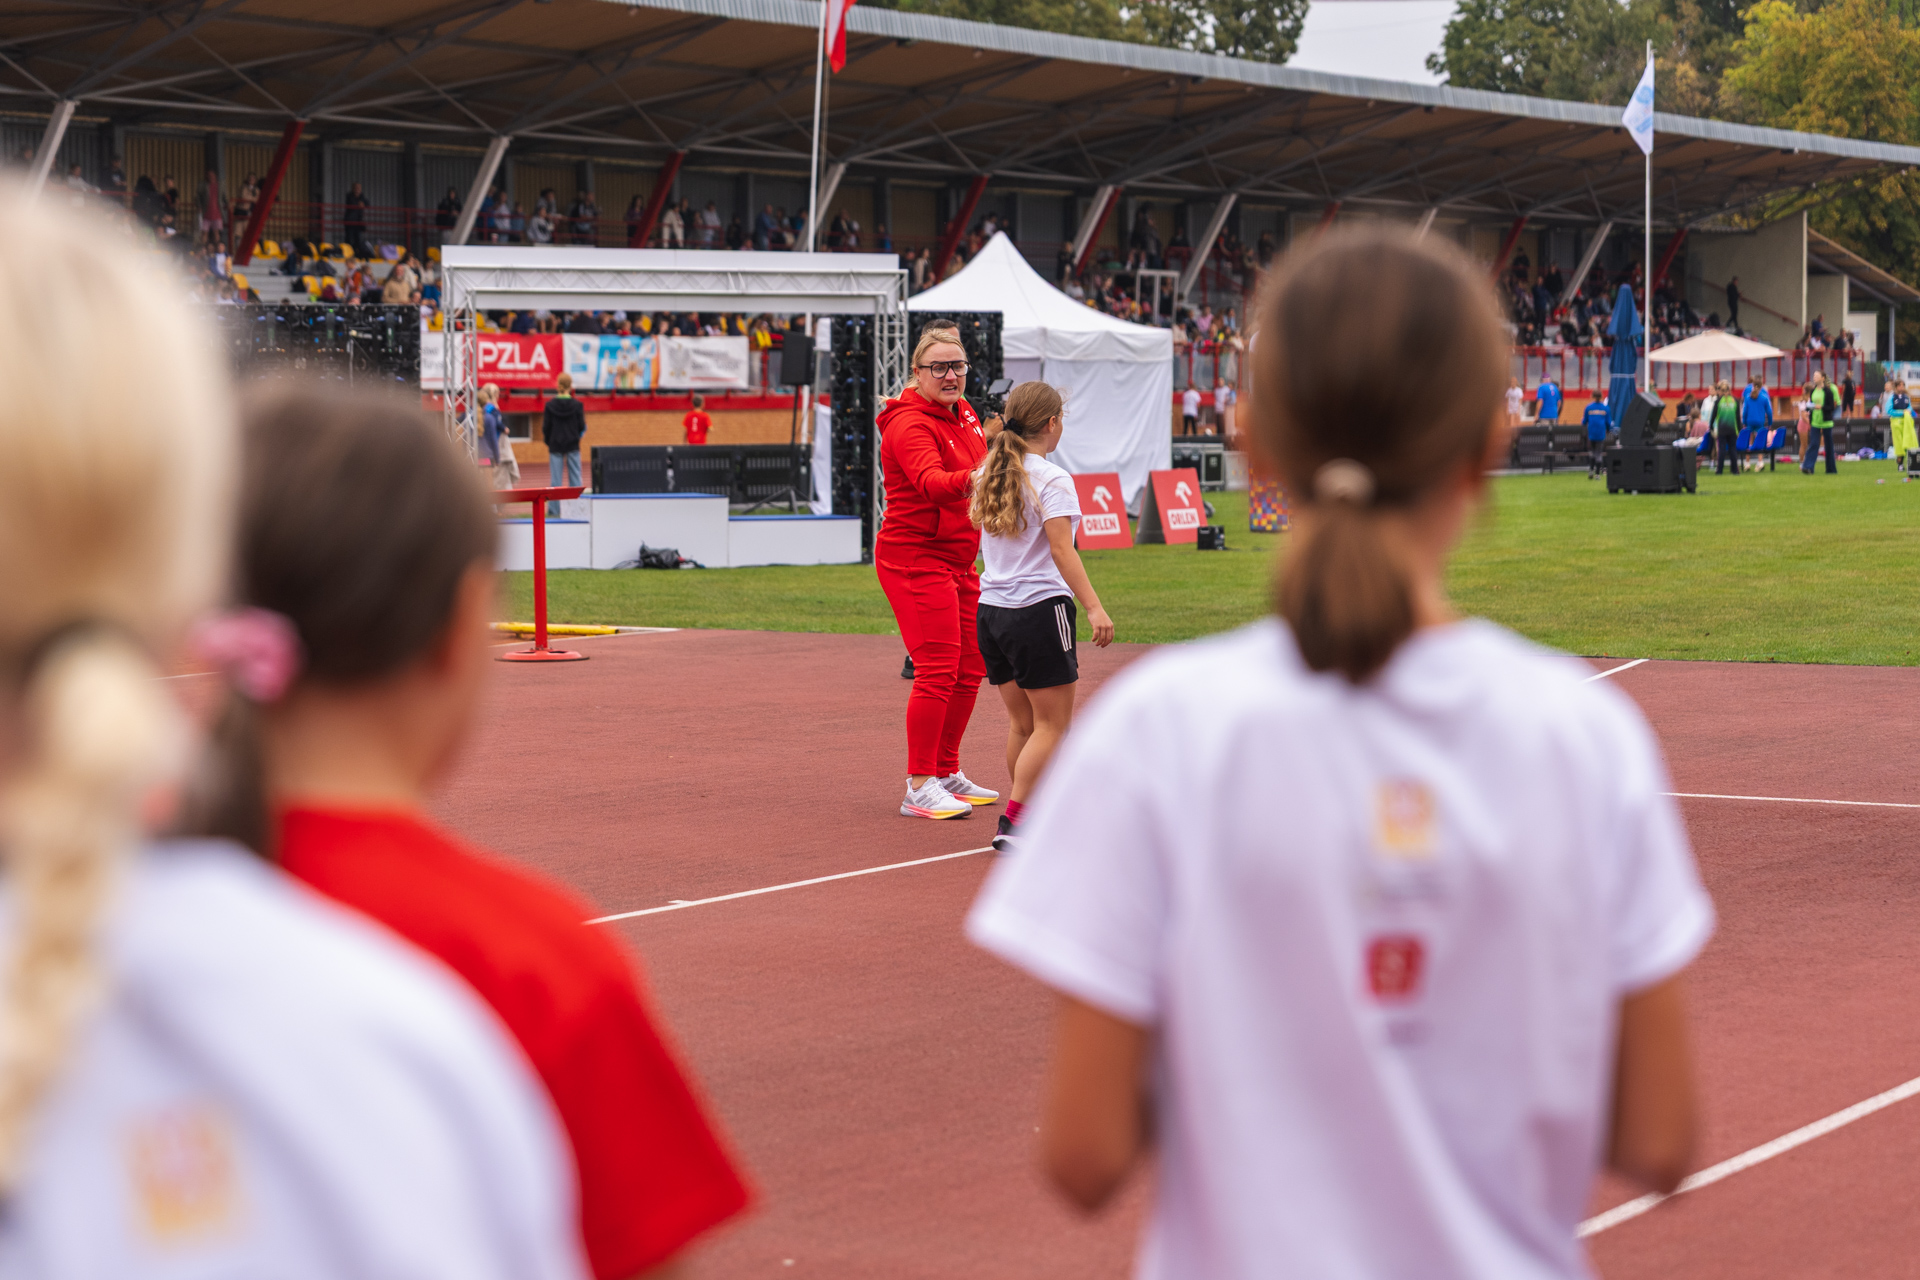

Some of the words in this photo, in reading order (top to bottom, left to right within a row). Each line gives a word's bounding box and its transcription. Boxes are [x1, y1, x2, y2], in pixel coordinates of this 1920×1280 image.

[478, 341, 551, 371] PZLA
[1086, 517, 1117, 531] ORLEN
[1171, 512, 1197, 525] ORLEN
